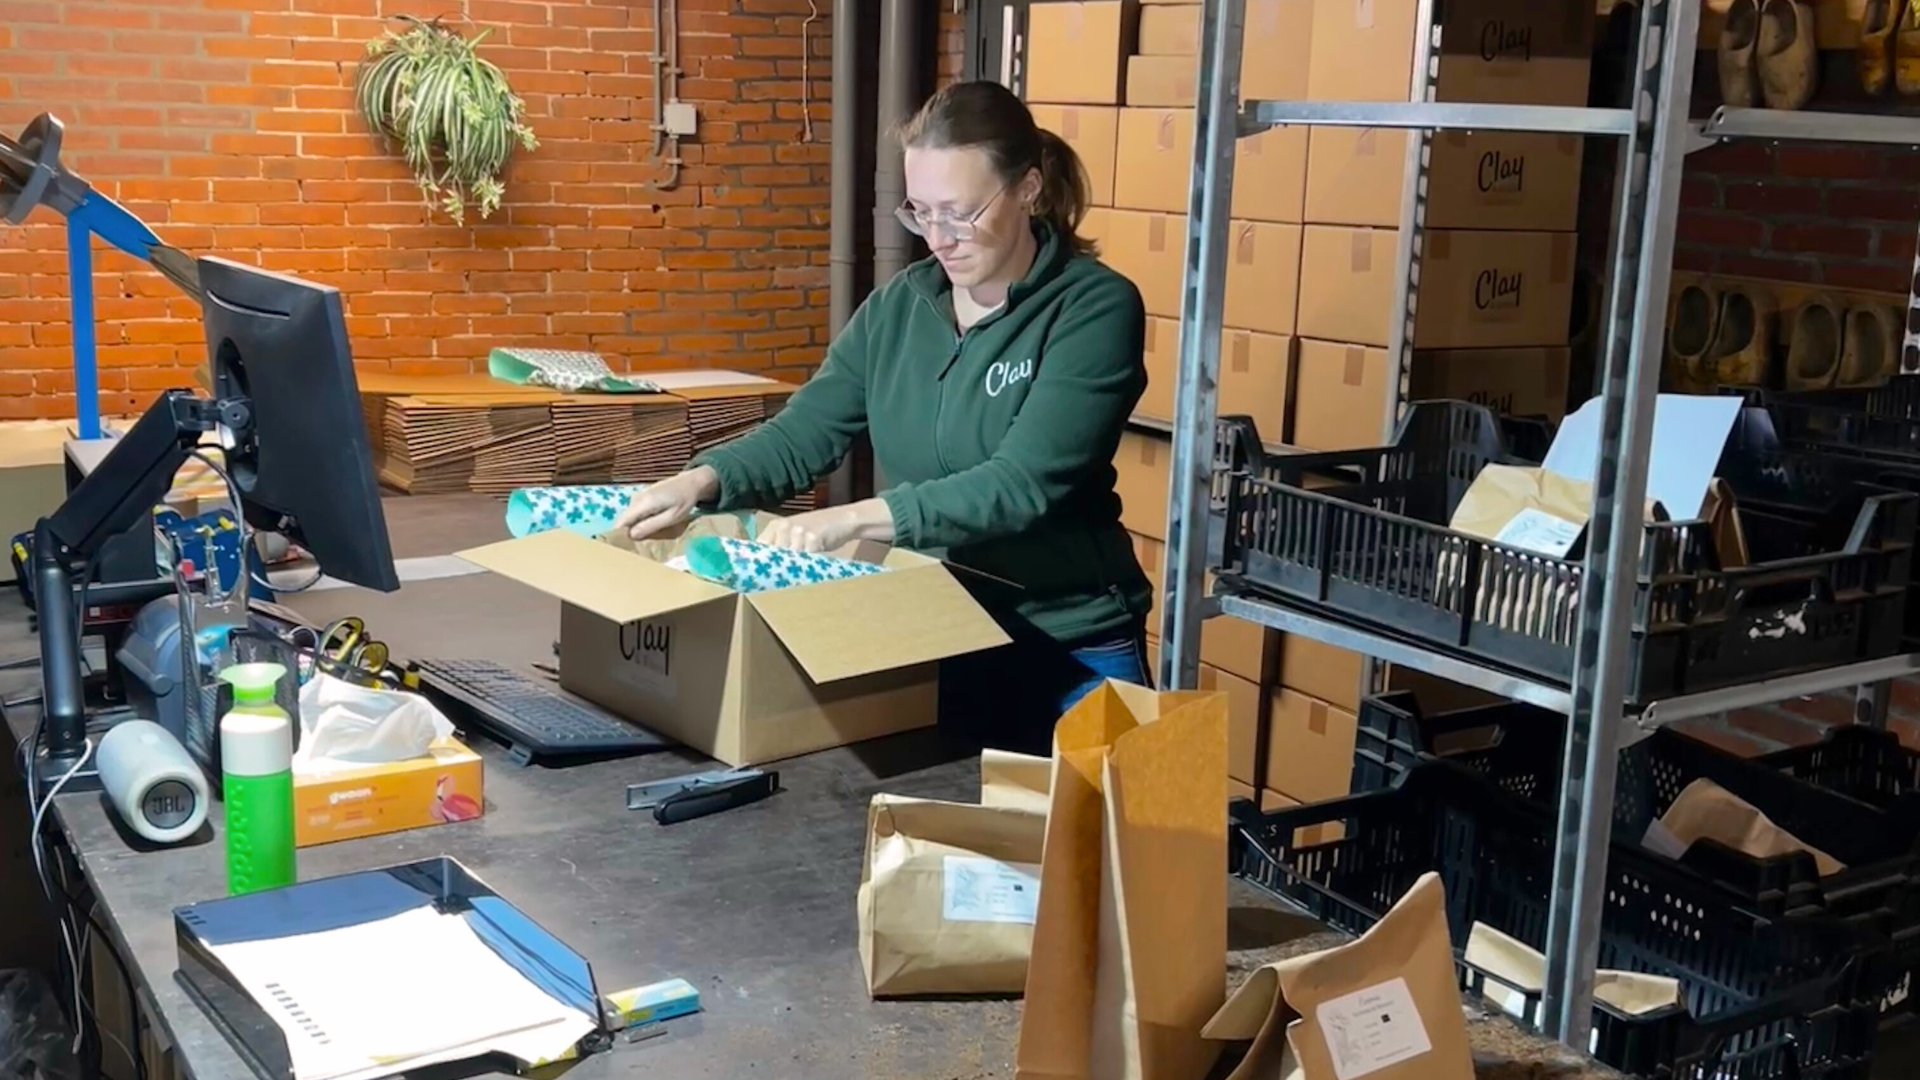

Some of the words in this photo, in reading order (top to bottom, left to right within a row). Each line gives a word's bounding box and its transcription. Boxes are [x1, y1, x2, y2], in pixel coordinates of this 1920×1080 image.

[1480, 20, 1532, 61] Clay
[1478, 151, 1524, 192] Clay
[1475, 268, 1522, 309] Clay
[985, 358, 1033, 397] Clay
[619, 620, 670, 676] Clay
[152, 795, 185, 814] JBL
